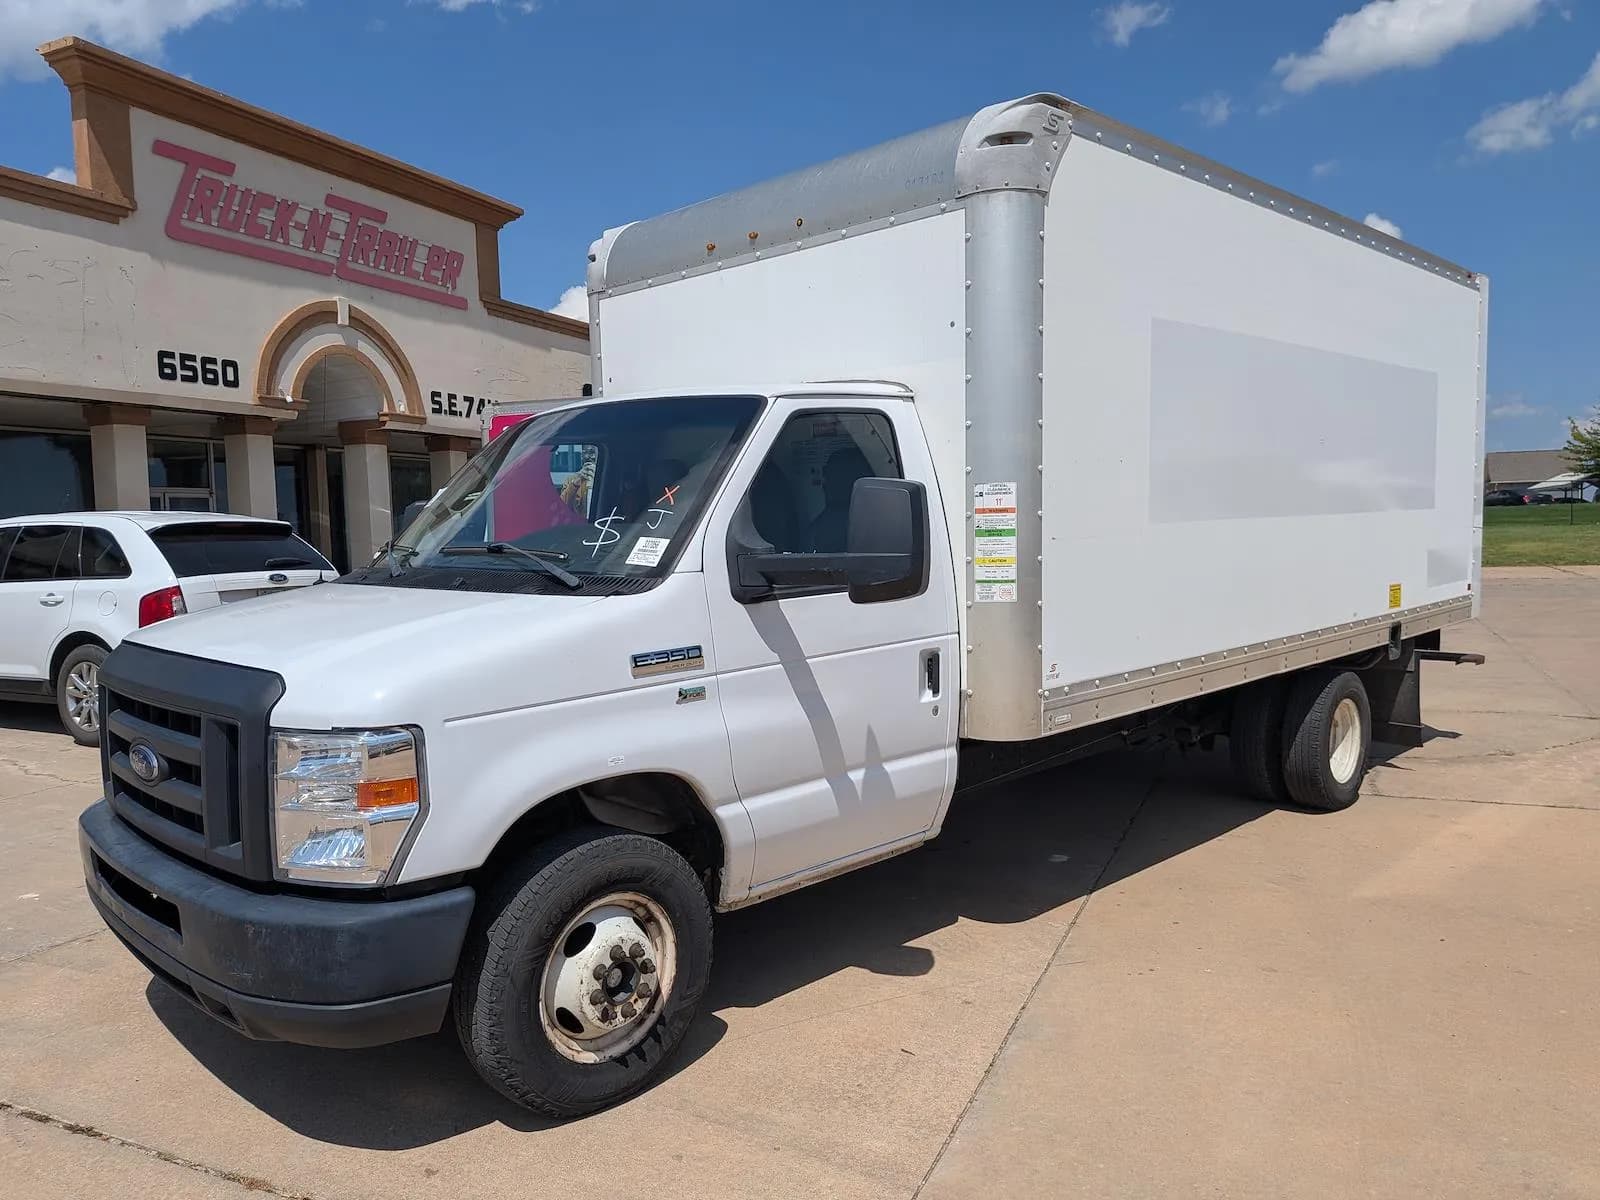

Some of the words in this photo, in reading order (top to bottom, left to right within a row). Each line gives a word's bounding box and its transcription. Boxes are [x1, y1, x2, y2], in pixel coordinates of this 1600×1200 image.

[157, 350, 239, 388] 6560
[582, 506, 625, 558] $
[646, 508, 674, 530] J
